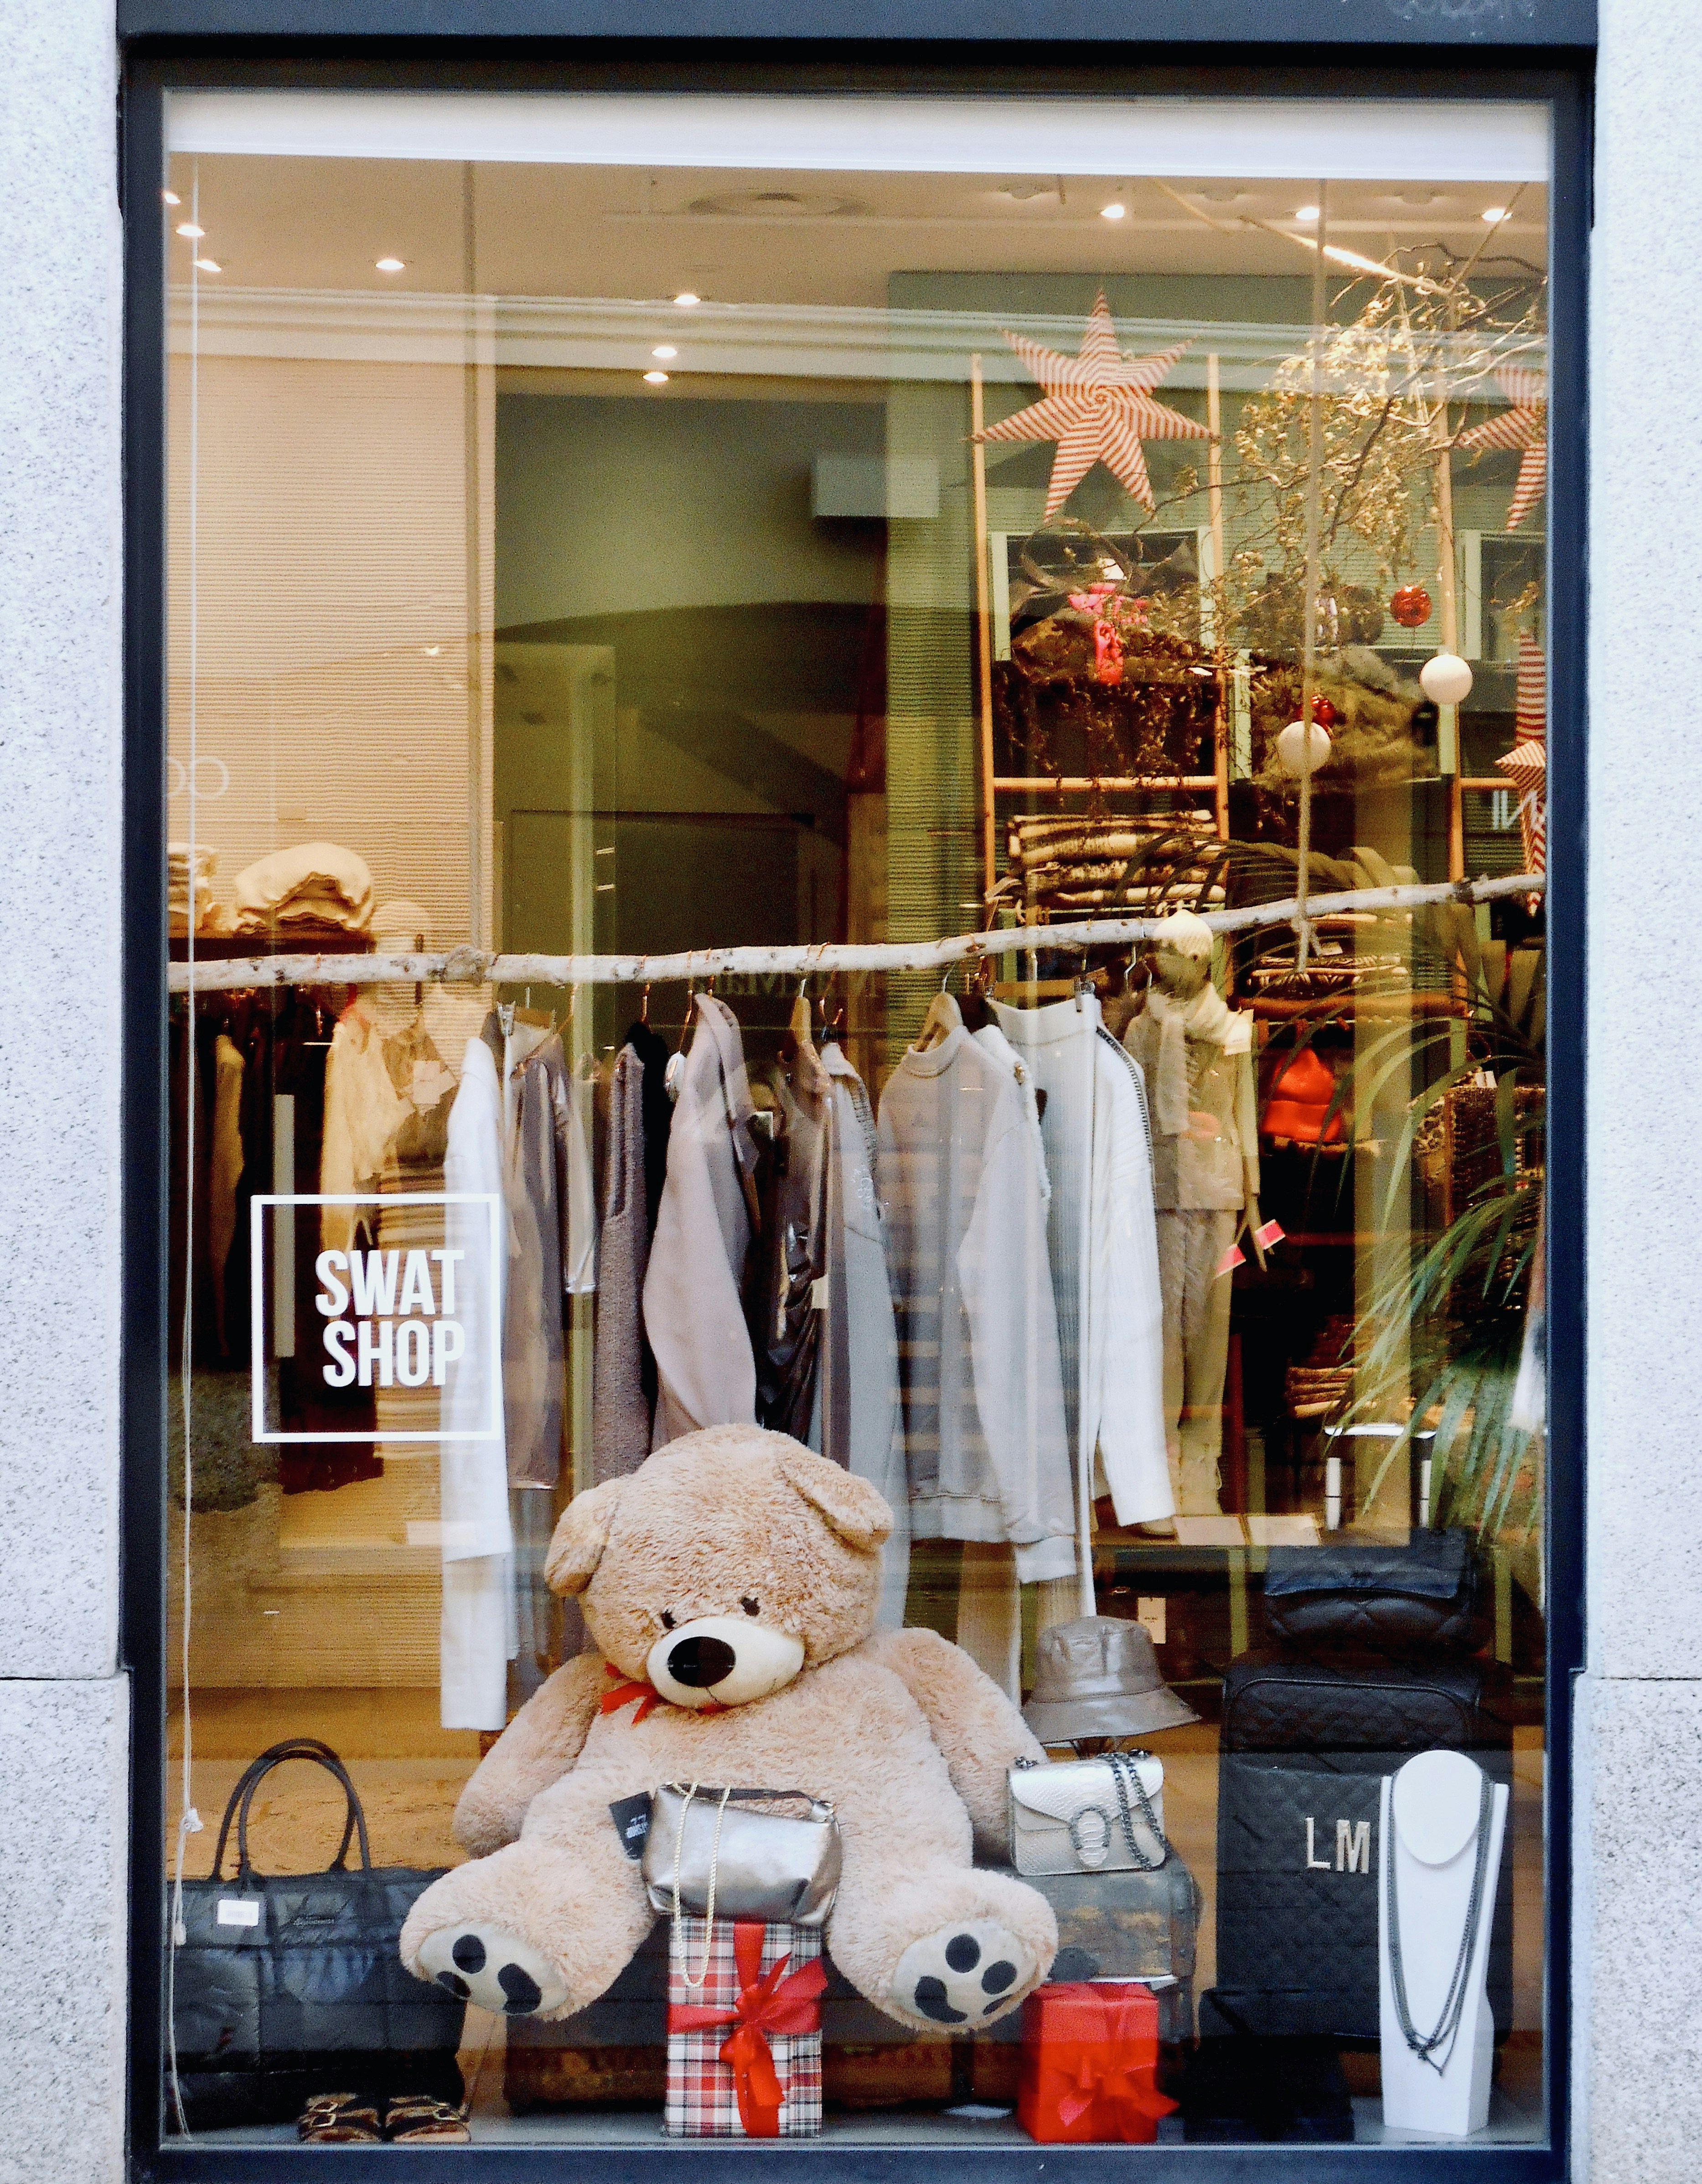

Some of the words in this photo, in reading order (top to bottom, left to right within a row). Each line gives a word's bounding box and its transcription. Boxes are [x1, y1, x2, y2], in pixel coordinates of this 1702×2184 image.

[315, 1249, 464, 1316] SWAT
[323, 1320, 465, 1387] SHOP
[1307, 1817, 1370, 1873] LM
